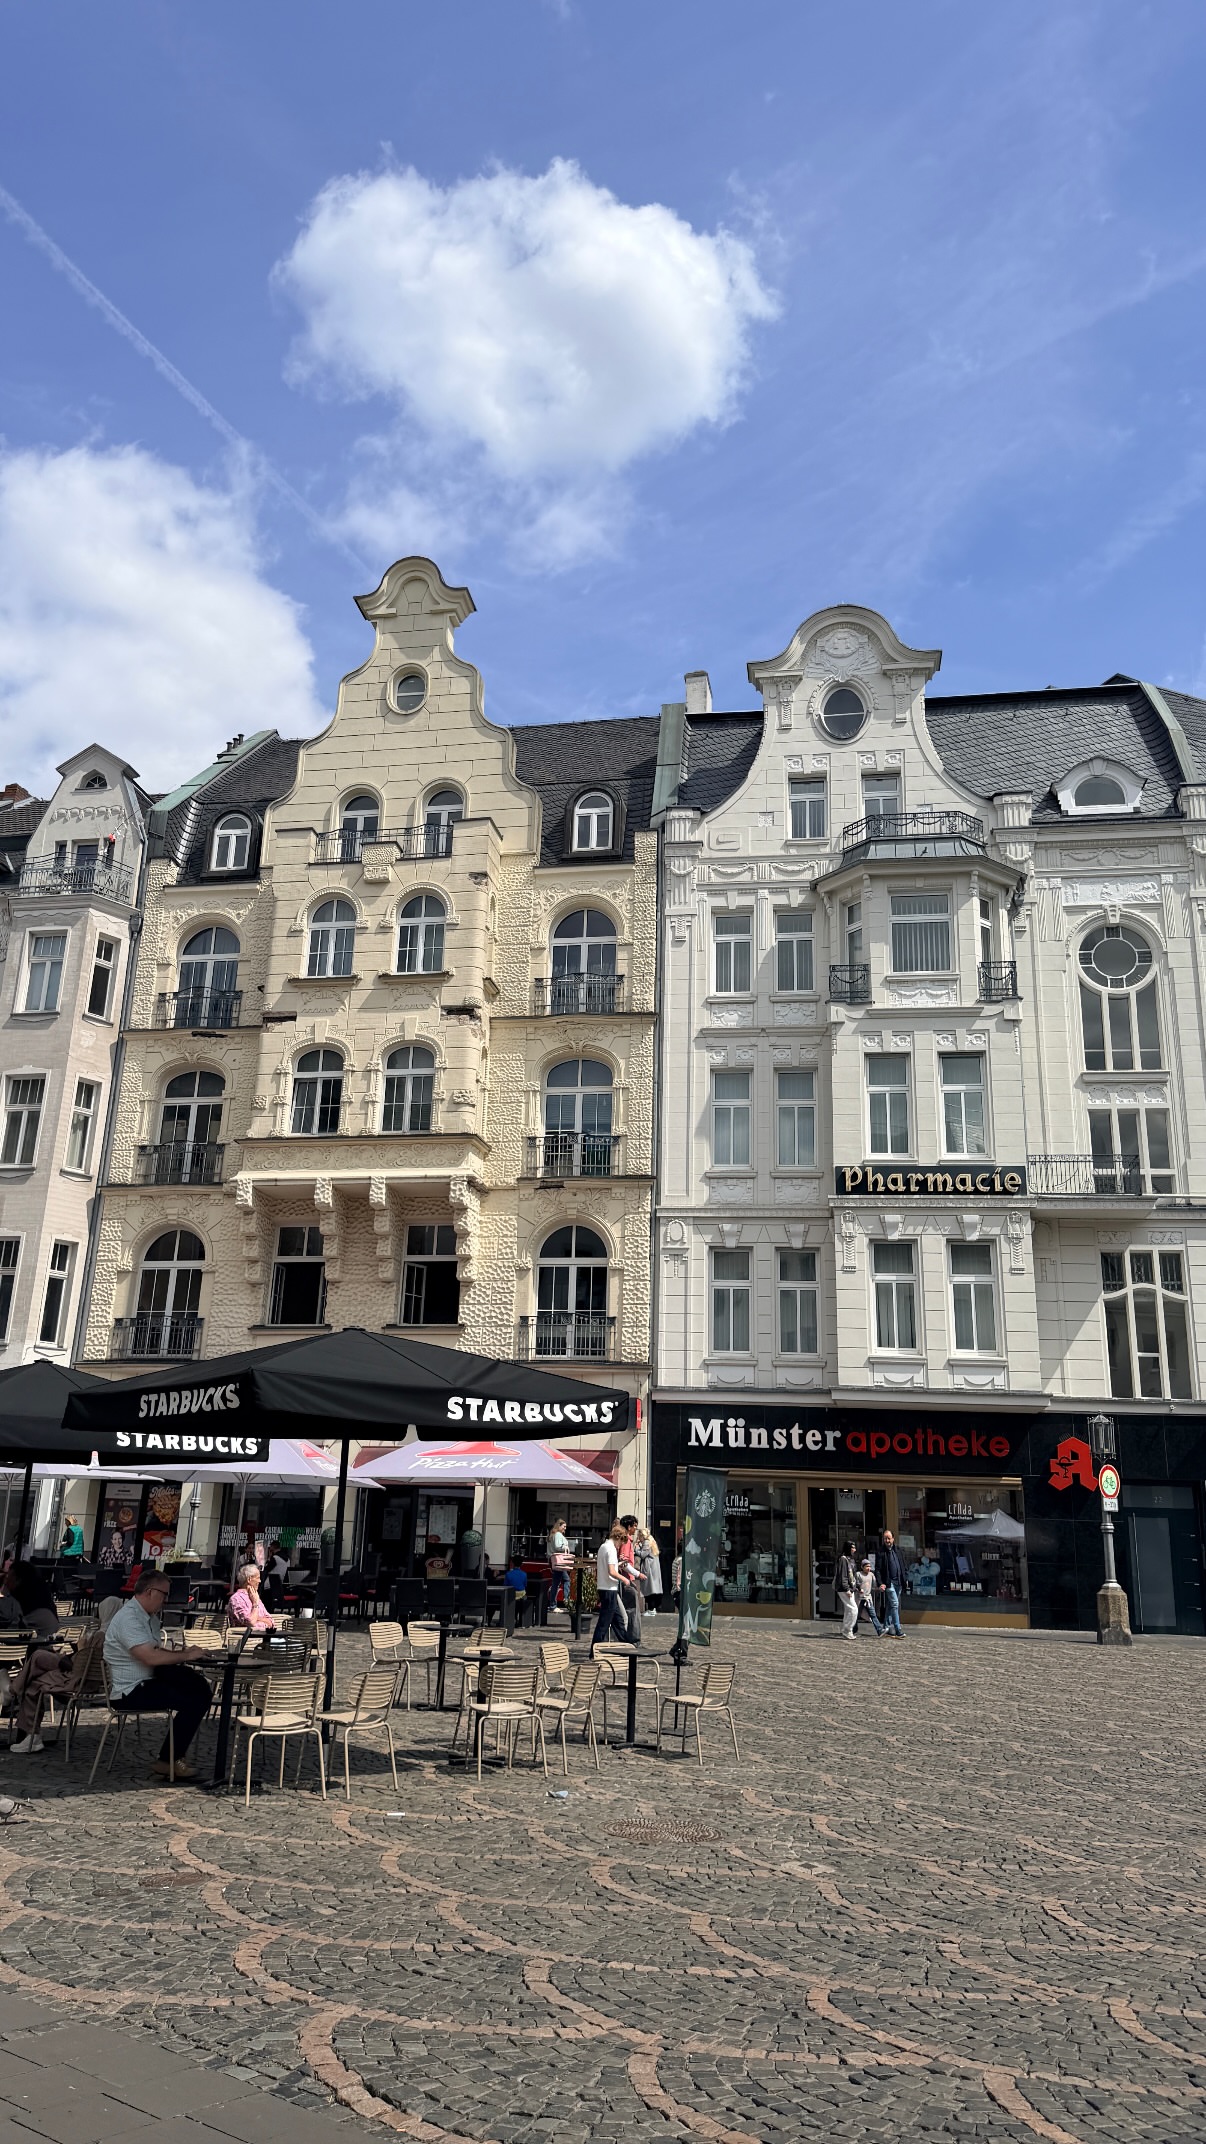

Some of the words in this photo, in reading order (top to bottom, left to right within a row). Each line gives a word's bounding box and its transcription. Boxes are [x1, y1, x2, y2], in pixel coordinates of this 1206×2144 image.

[842, 1166, 1022, 1192] Pharmacie
[138, 1383, 240, 1418] STARBUCKS
[446, 1396, 617, 1424] STARBUCKS
[116, 1431, 261, 1455] STARBUCKS
[687, 1418, 841, 1451] Münster
[846, 1429, 1009, 1458] apotheke
[408, 1457, 469, 1470] Pizza
[469, 1457, 518, 1469] Hut
